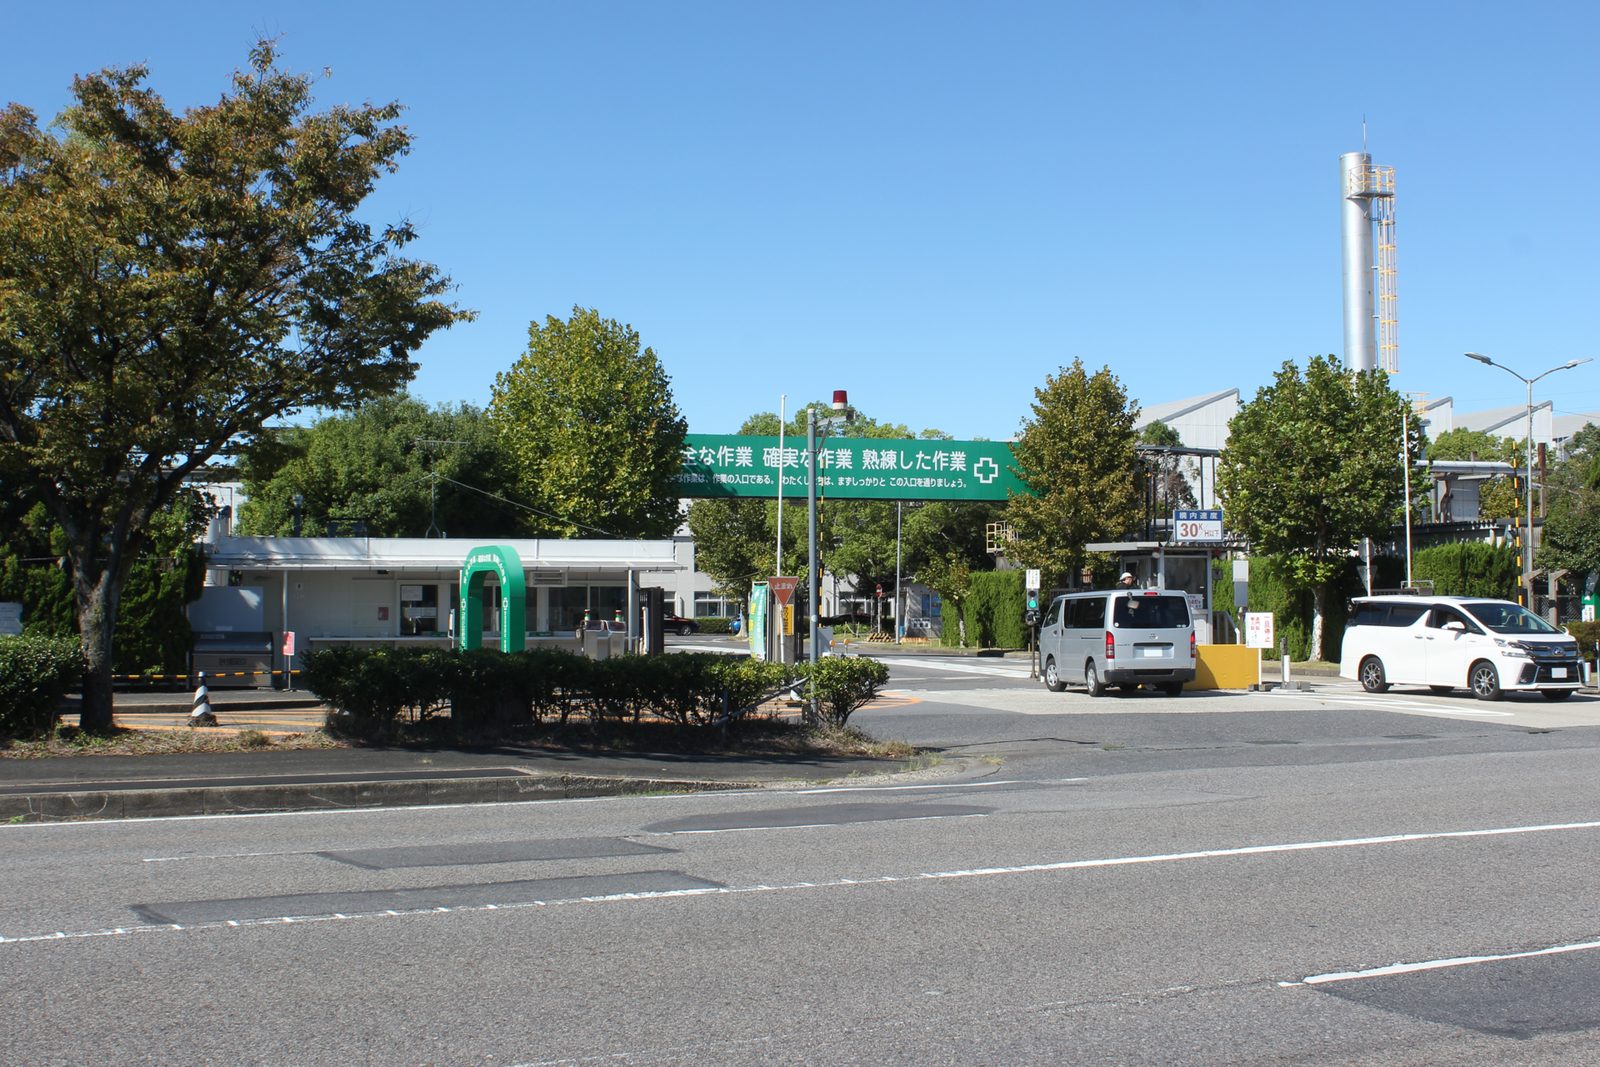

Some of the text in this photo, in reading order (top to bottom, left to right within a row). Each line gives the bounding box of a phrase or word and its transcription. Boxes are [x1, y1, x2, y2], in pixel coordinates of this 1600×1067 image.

[862, 448, 967, 472] 熟練した作業
